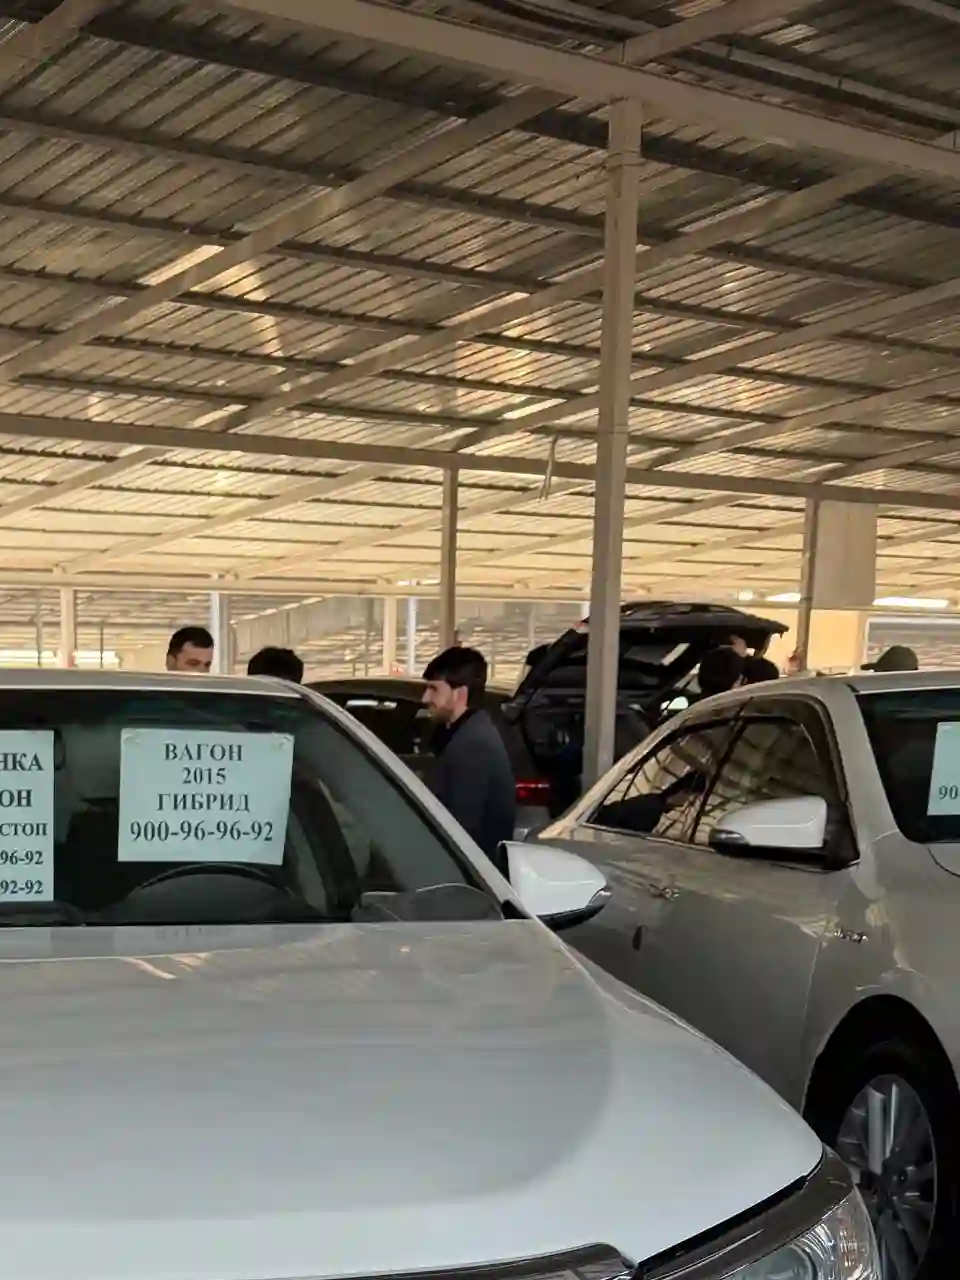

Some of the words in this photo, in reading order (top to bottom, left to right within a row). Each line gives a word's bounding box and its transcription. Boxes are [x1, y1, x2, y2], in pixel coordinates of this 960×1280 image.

[164, 743, 245, 762] ВАГОН
[182, 767, 227, 785] 2015
[157, 793, 251, 813] ГИБРИД
[130, 820, 274, 842] 900-96-96-92
